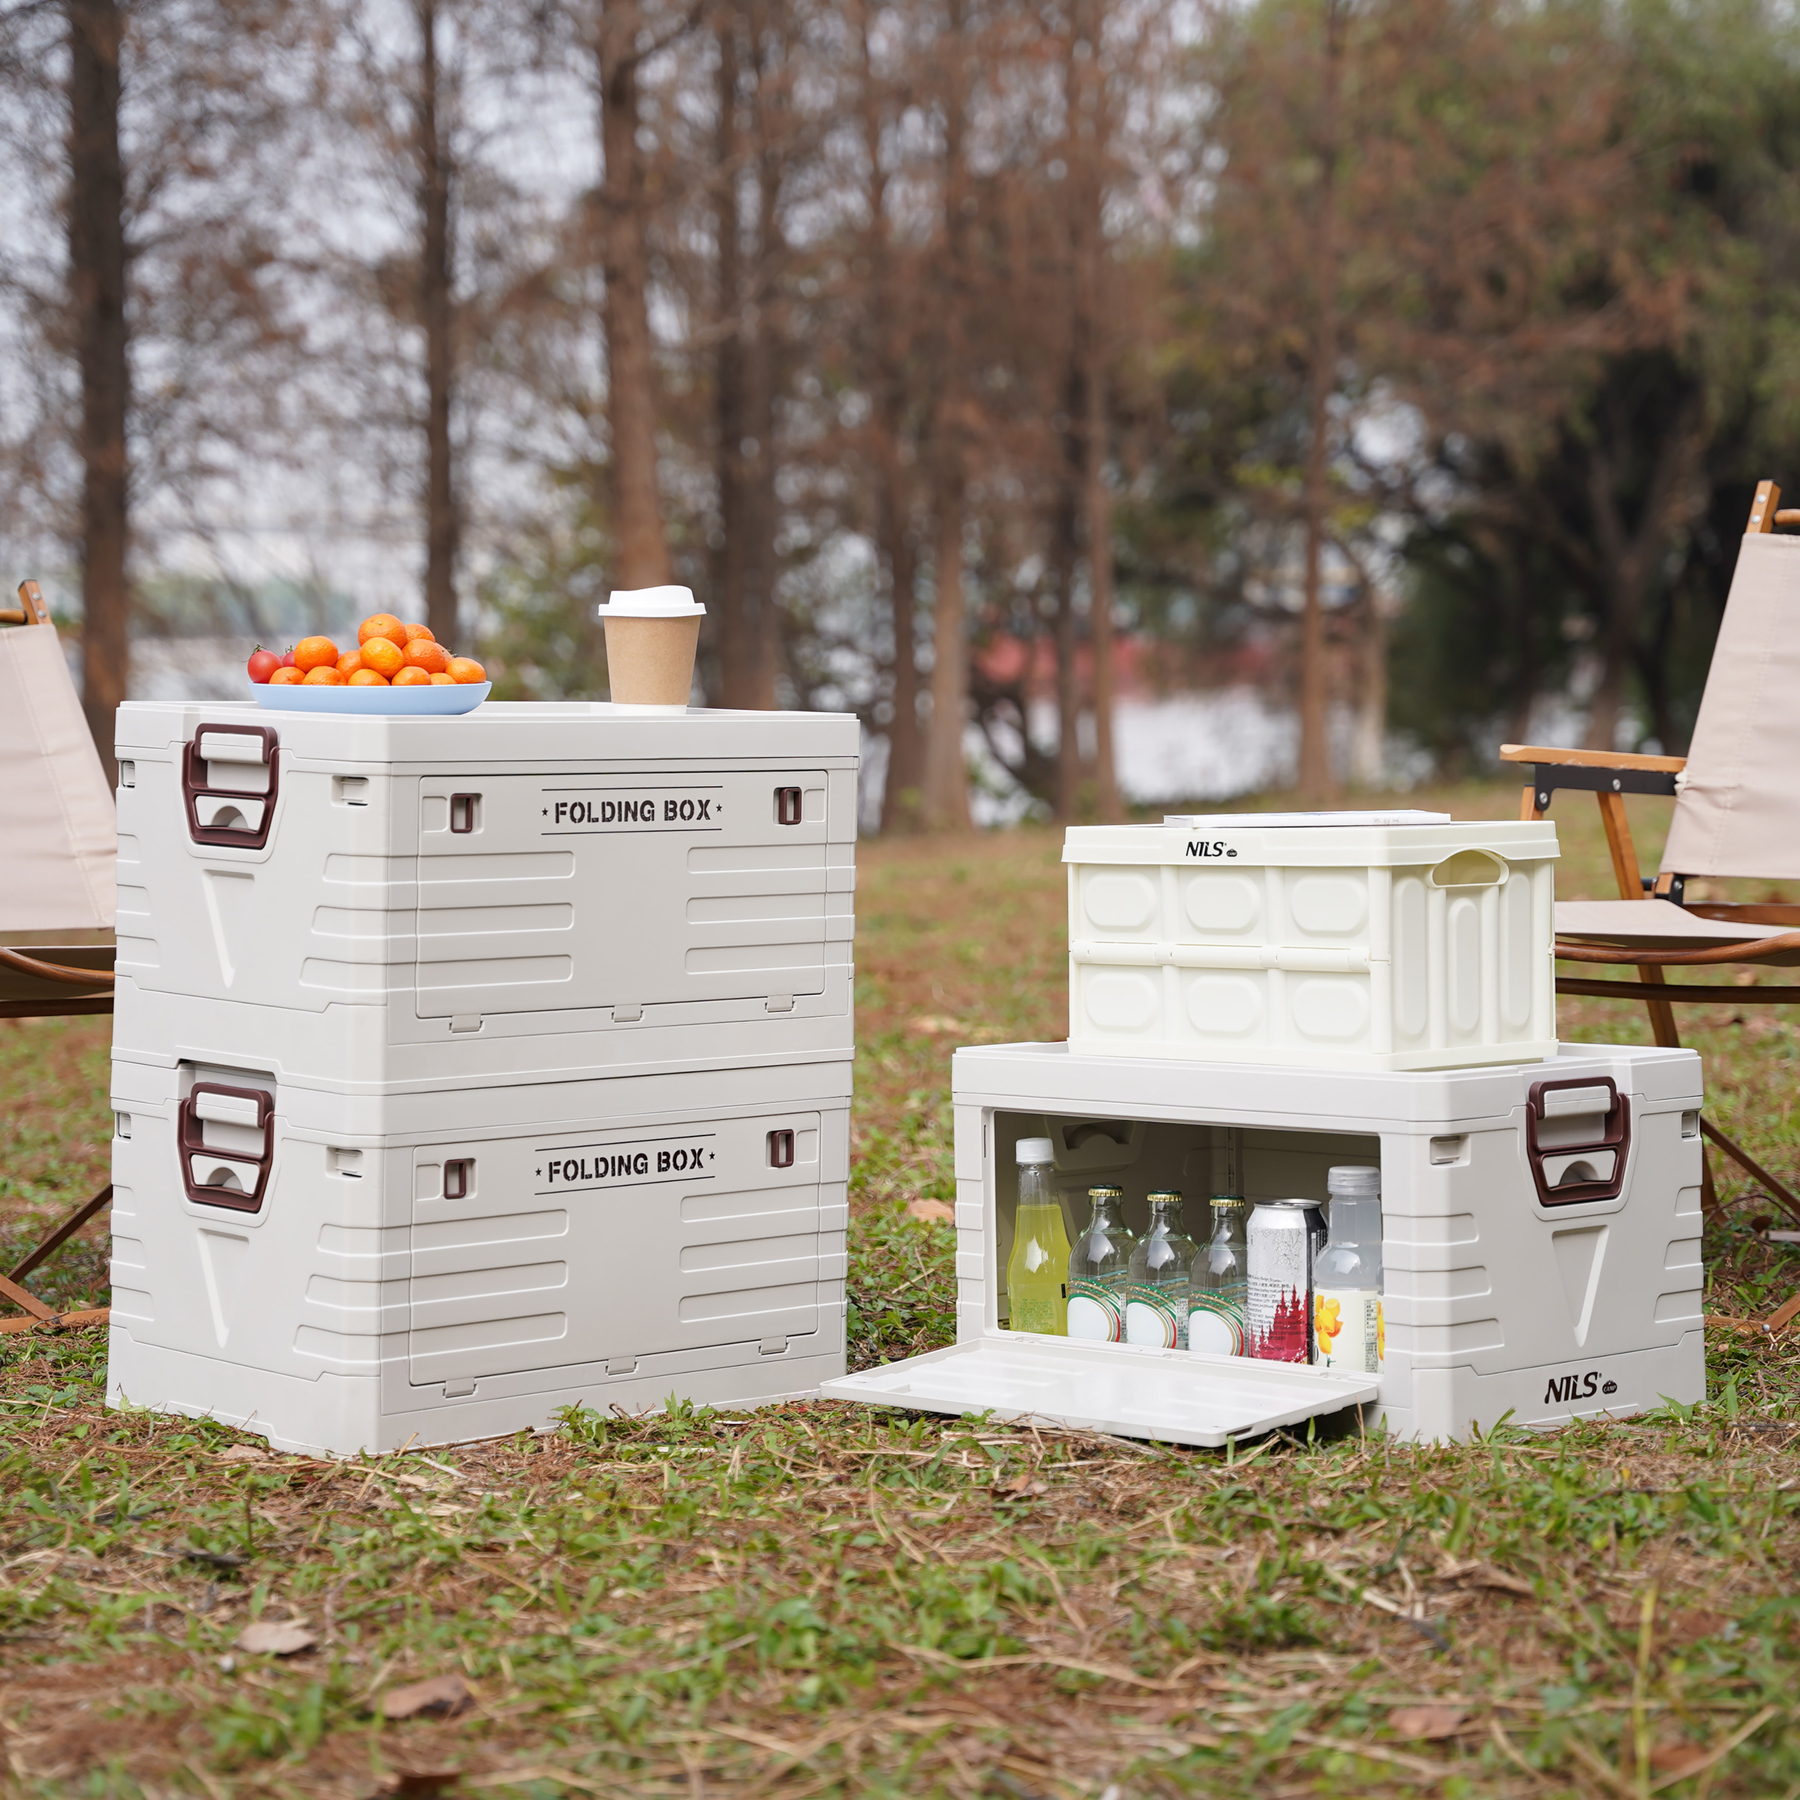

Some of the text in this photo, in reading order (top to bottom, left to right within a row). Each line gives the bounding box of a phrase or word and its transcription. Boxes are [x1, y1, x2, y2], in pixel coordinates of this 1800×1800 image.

[555, 799, 711, 824] FOLDING BOX
[1186, 841, 1224, 857] NILS
[548, 1147, 704, 1183] FOLDING BOX
[1544, 1371, 1598, 1404] NILS
